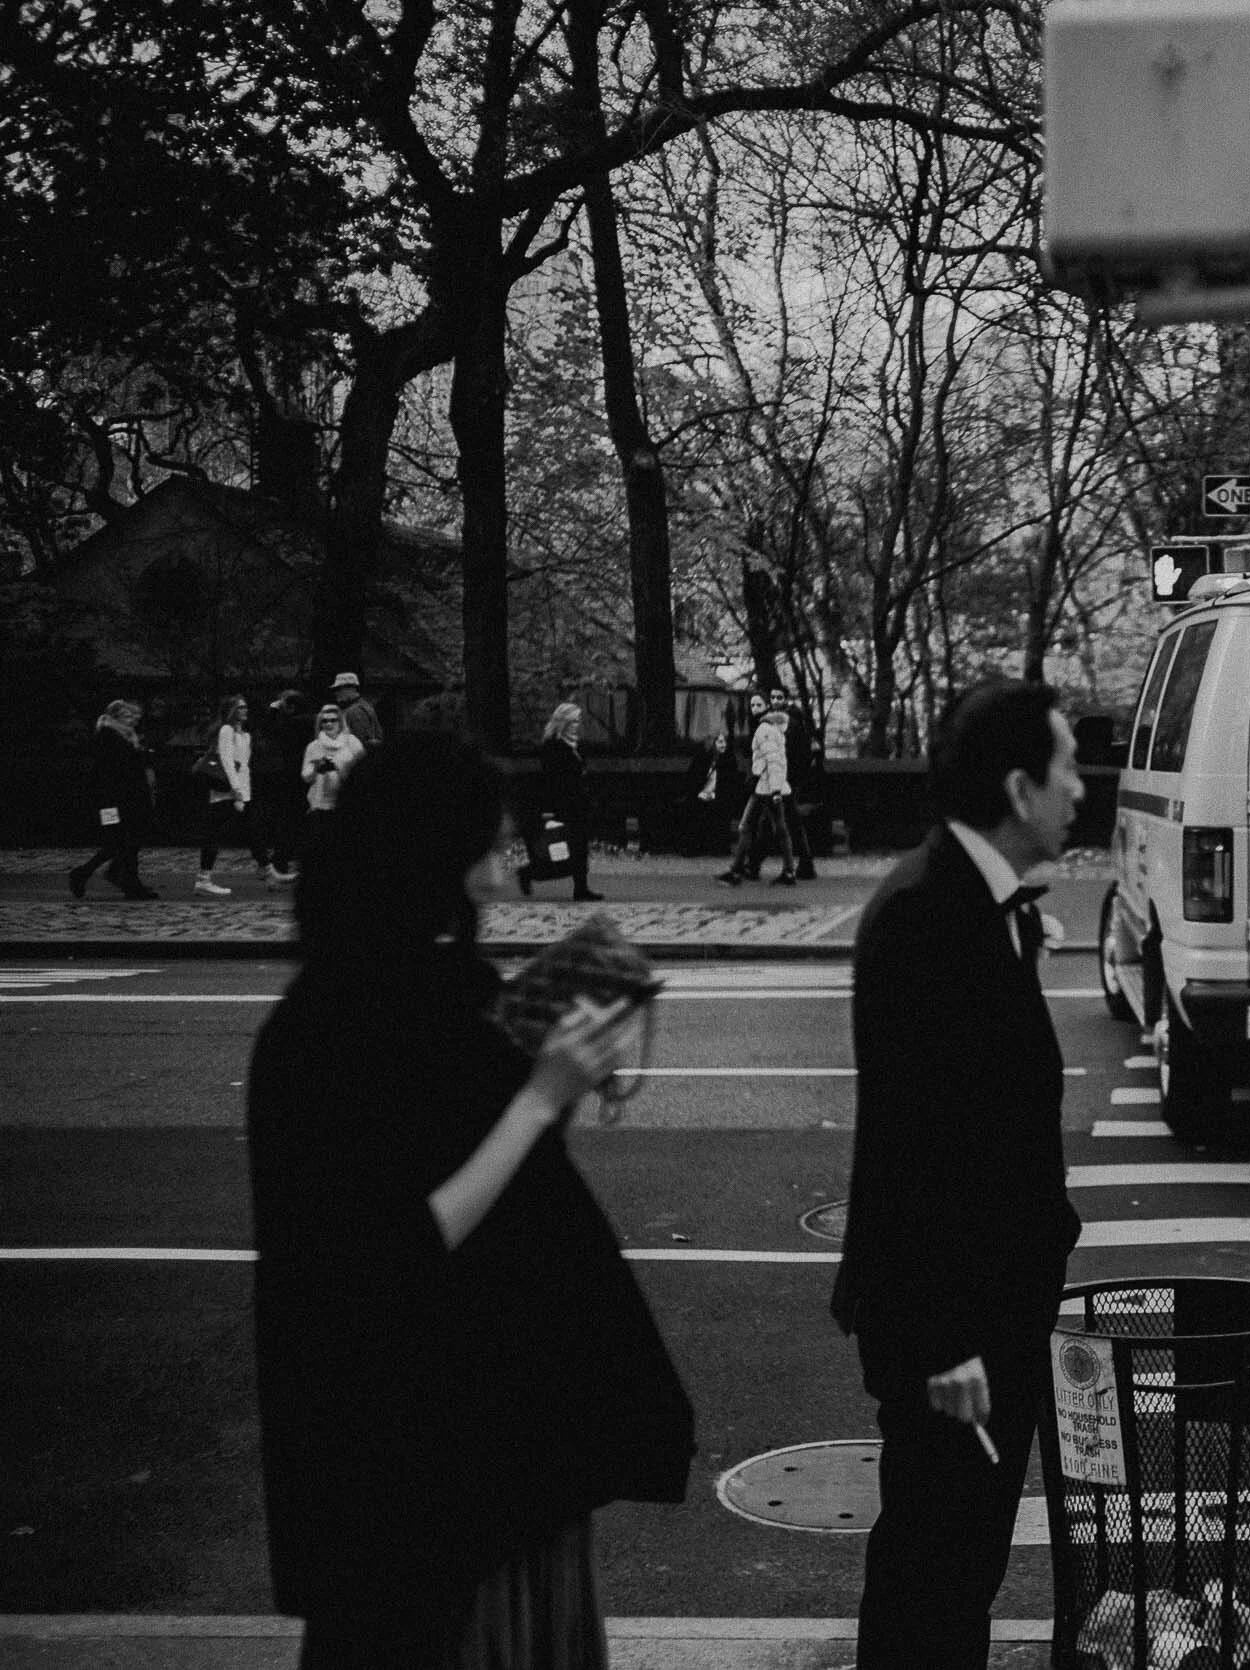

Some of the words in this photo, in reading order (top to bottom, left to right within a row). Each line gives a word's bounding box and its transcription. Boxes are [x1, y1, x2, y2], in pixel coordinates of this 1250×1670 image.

[1055, 1388, 1084, 1407] LITTER
[1057, 1407, 1067, 1419] NO
[1068, 1411, 1116, 1427] HOUSEHOLD
[1073, 1421, 1098, 1434] TRASH
[1061, 1431, 1072, 1443] NO
[1090, 1462, 1119, 1479] FINE
